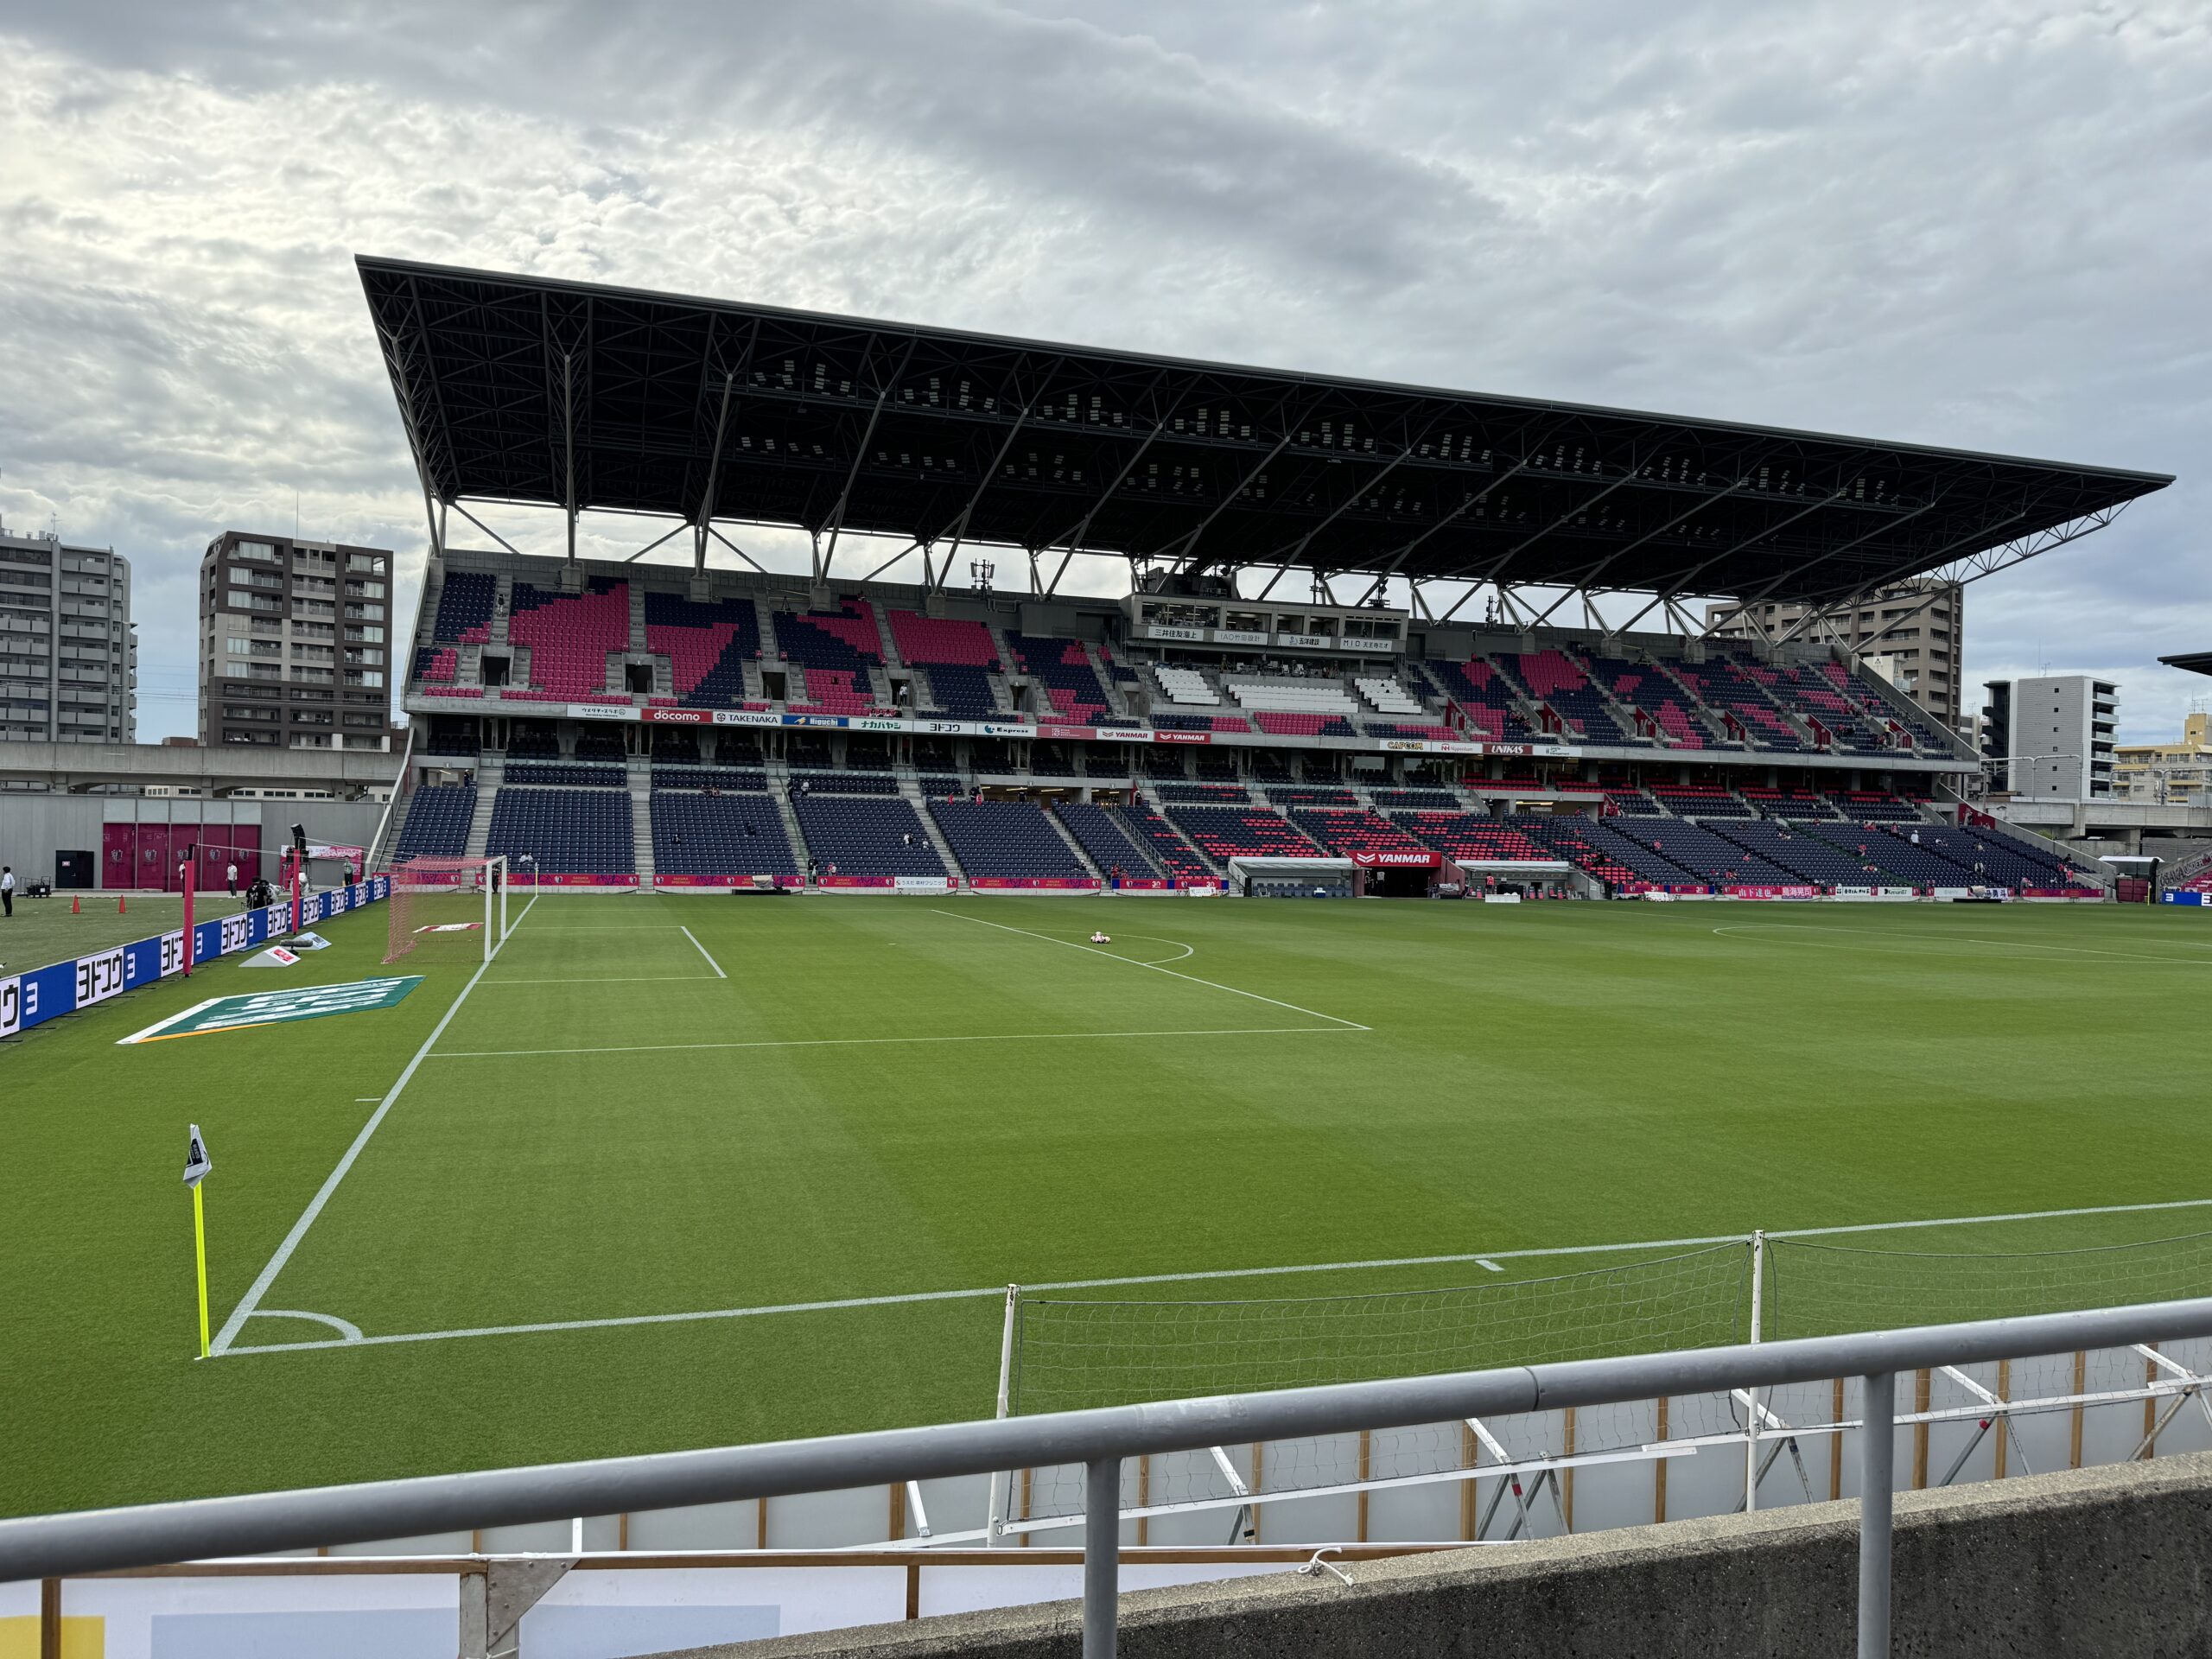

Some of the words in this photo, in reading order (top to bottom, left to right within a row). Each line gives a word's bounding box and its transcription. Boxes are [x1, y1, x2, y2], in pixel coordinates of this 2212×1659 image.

[1155, 629, 1196, 639] 三井住友海上
[1299, 637, 1319, 645] 五洋建設
[654, 709, 700, 721] docomo
[728, 715, 778, 723] TAKENAKA
[861, 721, 901, 729] ナカバヤシ
[930, 723, 960, 732] ヨドコウ
[1388, 741, 1424, 750] CAPCOM
[1491, 745, 1524, 754] UNIKAS
[1378, 854, 1430, 863] YANMAR
[1782, 887, 1812, 896] 鳥海晃司
[331, 891, 345, 912] ヨドコウ
[303, 898, 319, 922] ヨドコウ
[268, 906, 286, 933] ヨドコウ
[222, 918, 247, 950] ヨドコウ
[78, 953, 123, 1002] ヨドコウ
[0, 984, 19, 1028] ウ
